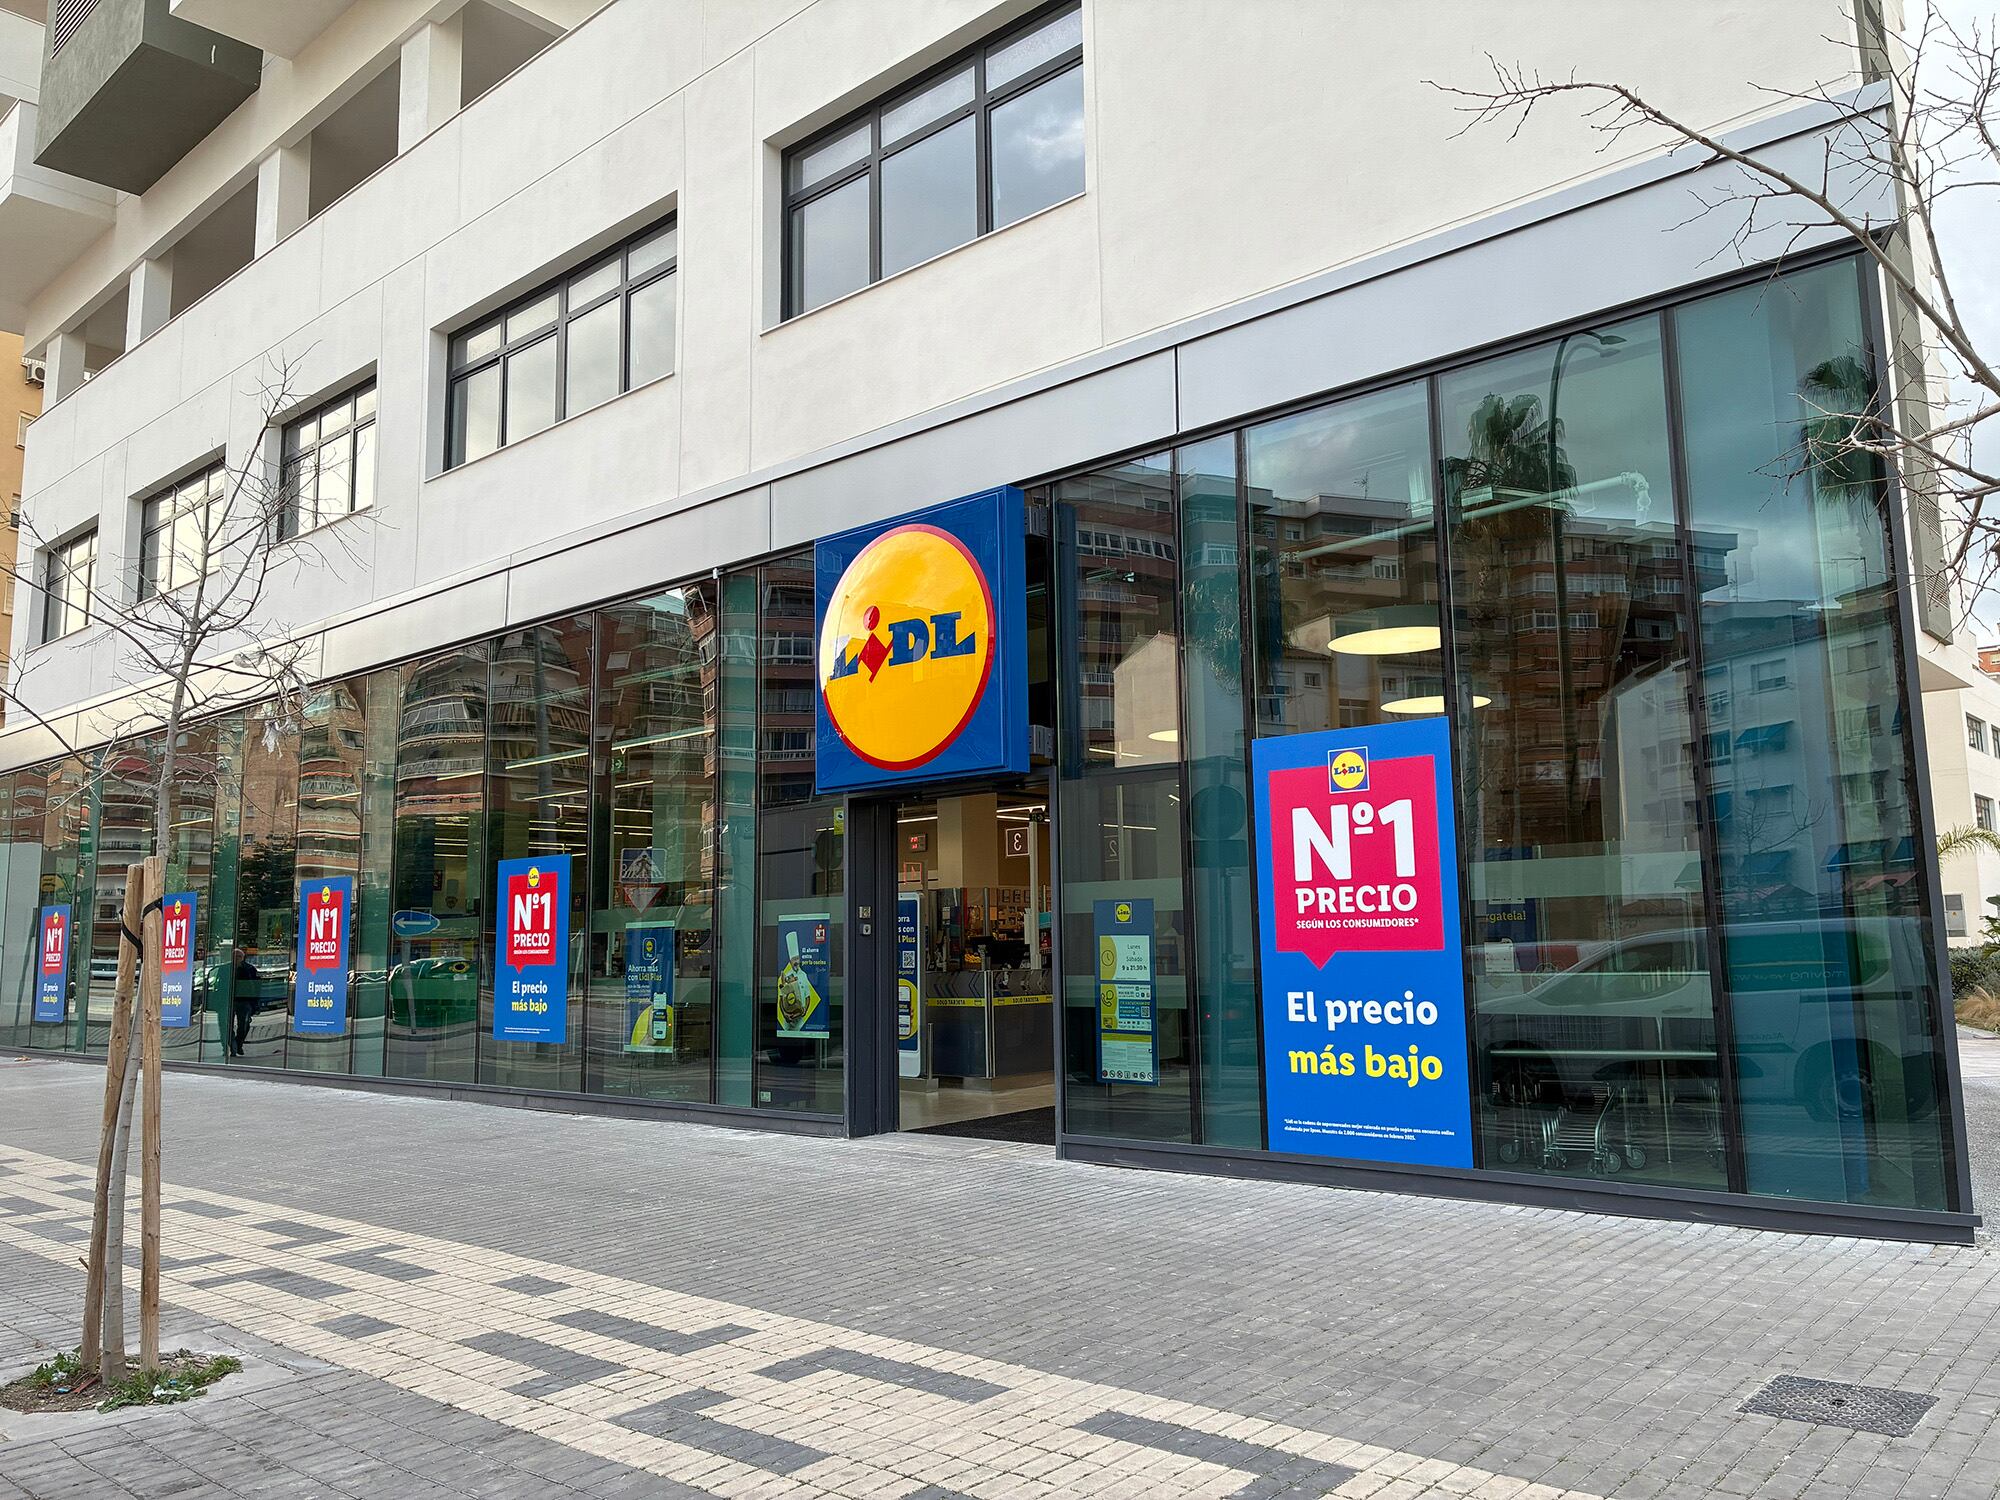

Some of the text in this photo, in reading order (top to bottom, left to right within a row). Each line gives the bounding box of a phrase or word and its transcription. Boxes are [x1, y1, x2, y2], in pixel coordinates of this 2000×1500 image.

[830, 606, 976, 683] LIDL
[1334, 763, 1364, 776] LIDL
[1295, 884, 1418, 914] PRECIO
[1296, 918, 1324, 929] SEGÚN
[1326, 919, 1341, 929] LOS
[1486, 910, 1526, 923] rgatela!
[310, 941, 336, 953] PRECIO
[514, 933, 550, 947] PRECIO
[165, 948, 185, 958] PRECIO
[167, 982, 182, 994] precio
[308, 981, 333, 995] El precio
[512, 980, 547, 997] El precio
[307, 996, 333, 1010] más bajo
[512, 999, 548, 1015] más bajo
[1287, 990, 1438, 1031] El precio
[1288, 1044, 1443, 1088] más bajo
